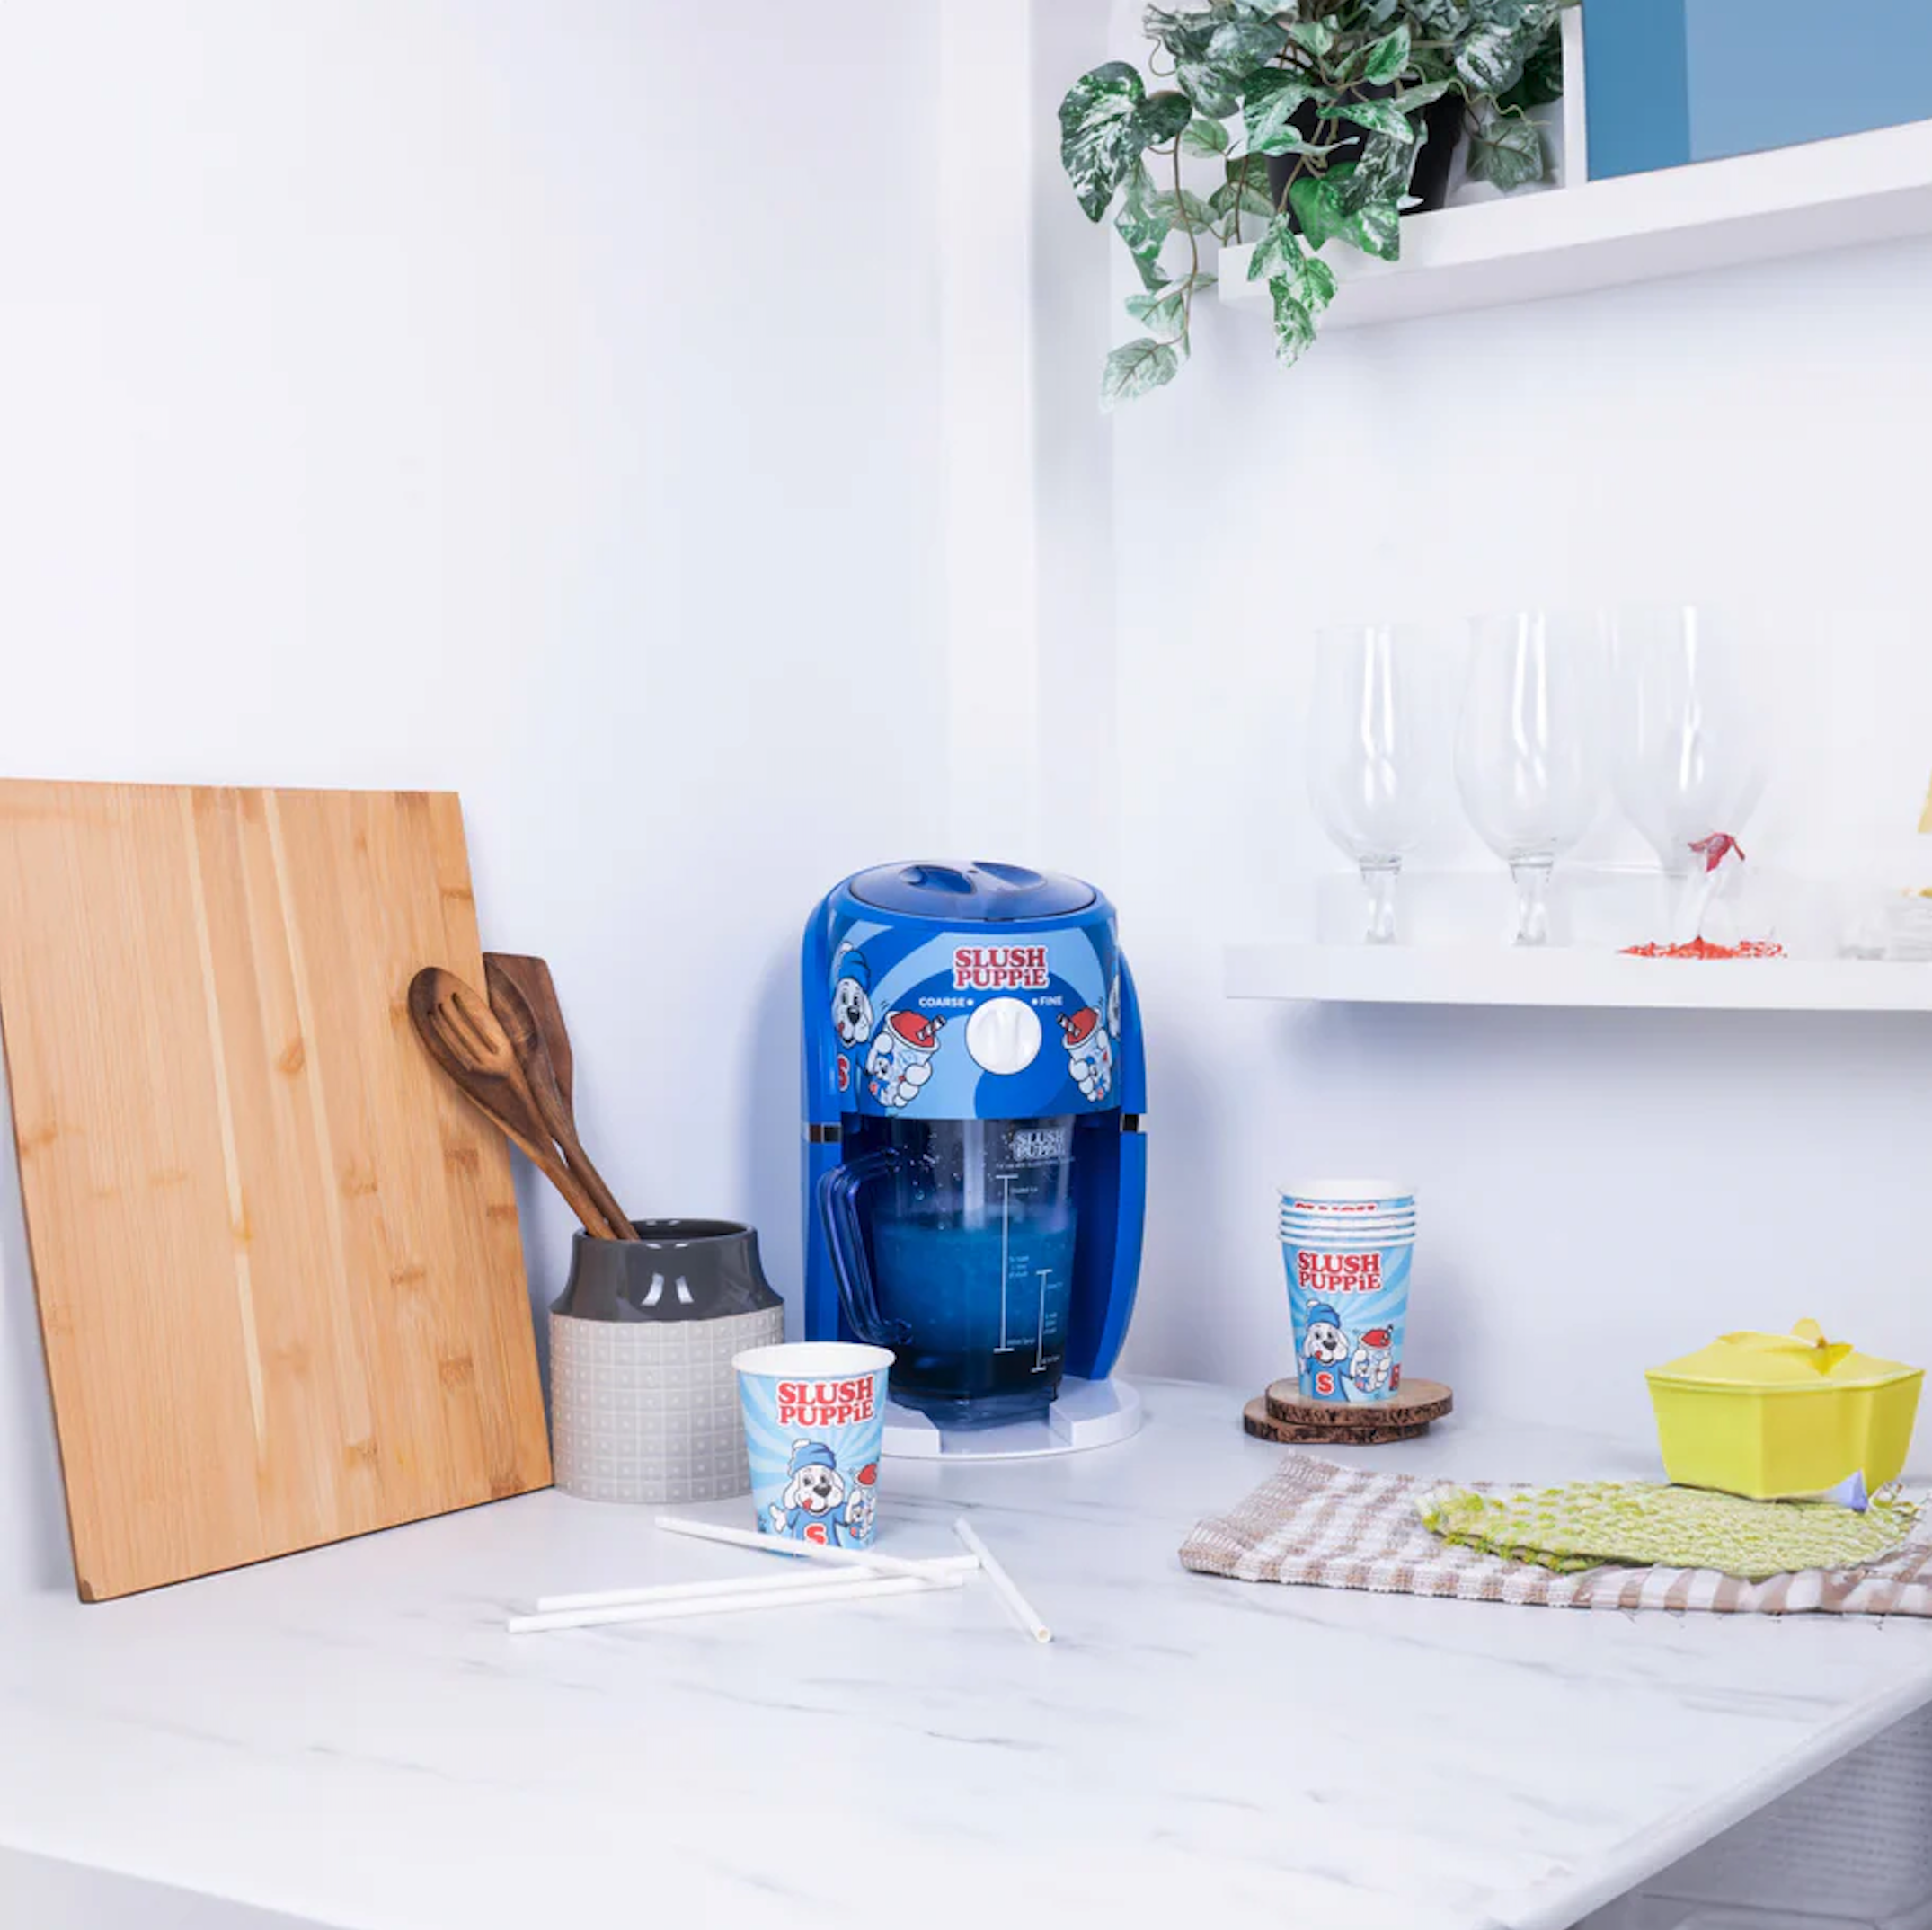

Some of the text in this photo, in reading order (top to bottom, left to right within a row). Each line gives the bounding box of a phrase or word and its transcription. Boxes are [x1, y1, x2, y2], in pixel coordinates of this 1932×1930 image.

[955, 948, 1046, 969] SLUSH
[919, 996, 1064, 1008] COARSE FINE
[1298, 1251, 1380, 1273] SLUSH
[778, 1376, 874, 1404] SLUSH
[1316, 1374, 1334, 1393] S
[806, 1525, 826, 1545] S
